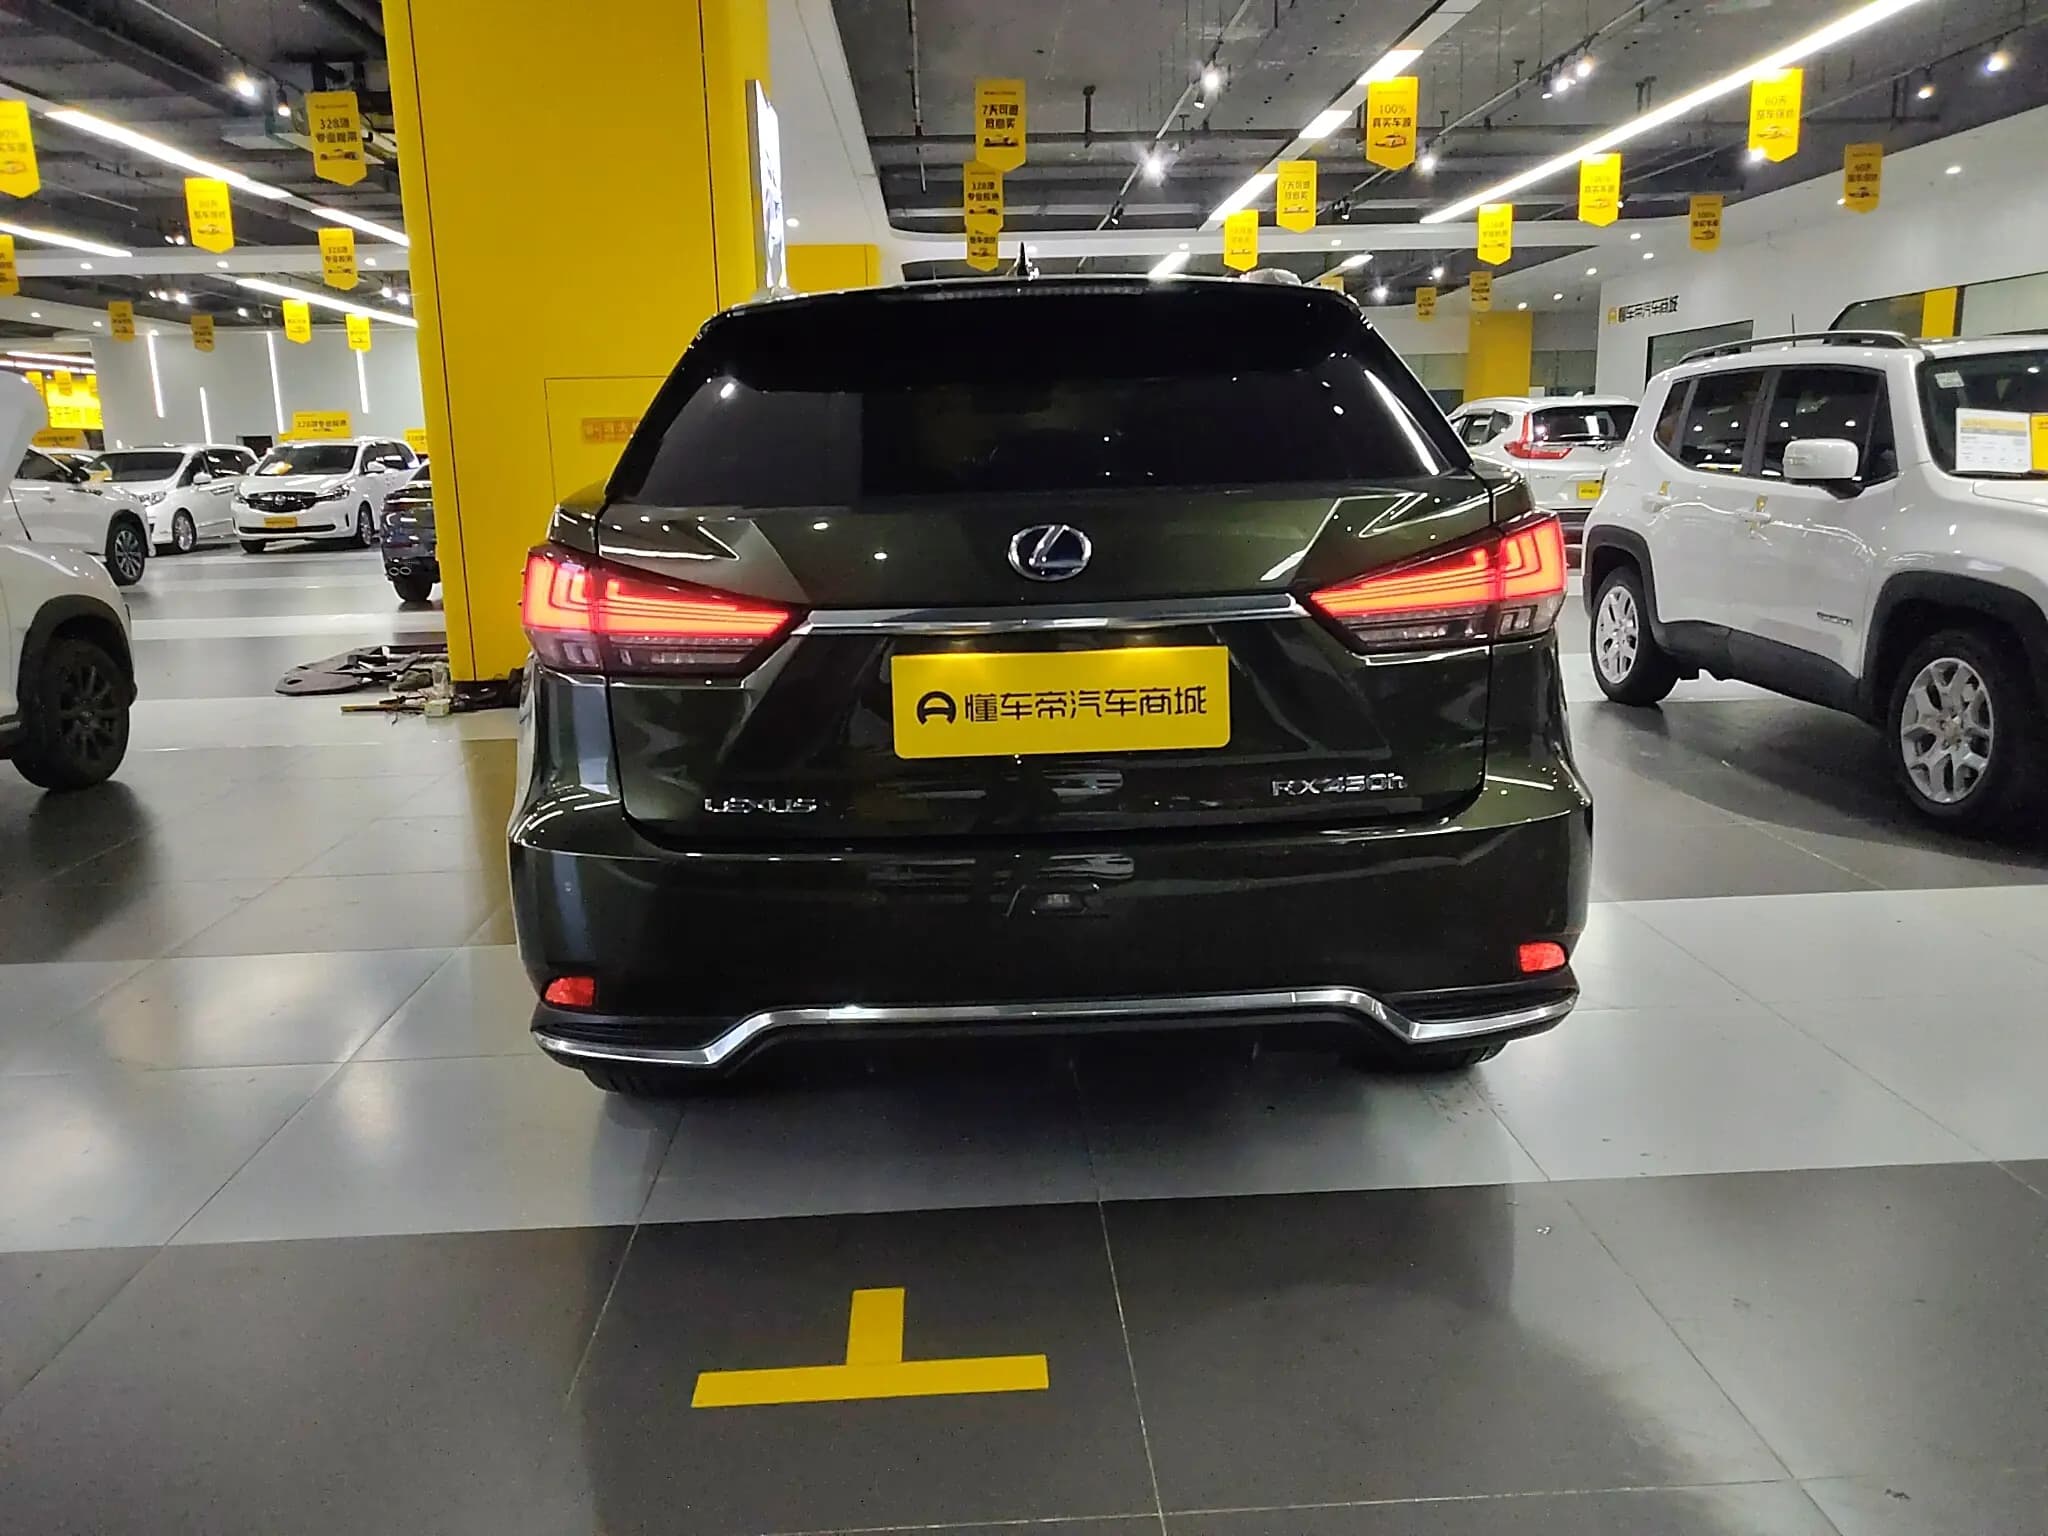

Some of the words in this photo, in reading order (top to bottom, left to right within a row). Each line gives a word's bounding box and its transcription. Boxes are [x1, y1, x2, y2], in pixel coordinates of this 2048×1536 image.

[964, 685, 1208, 723] 懂车帝汽车商城
[704, 797, 817, 814] LEXUS
